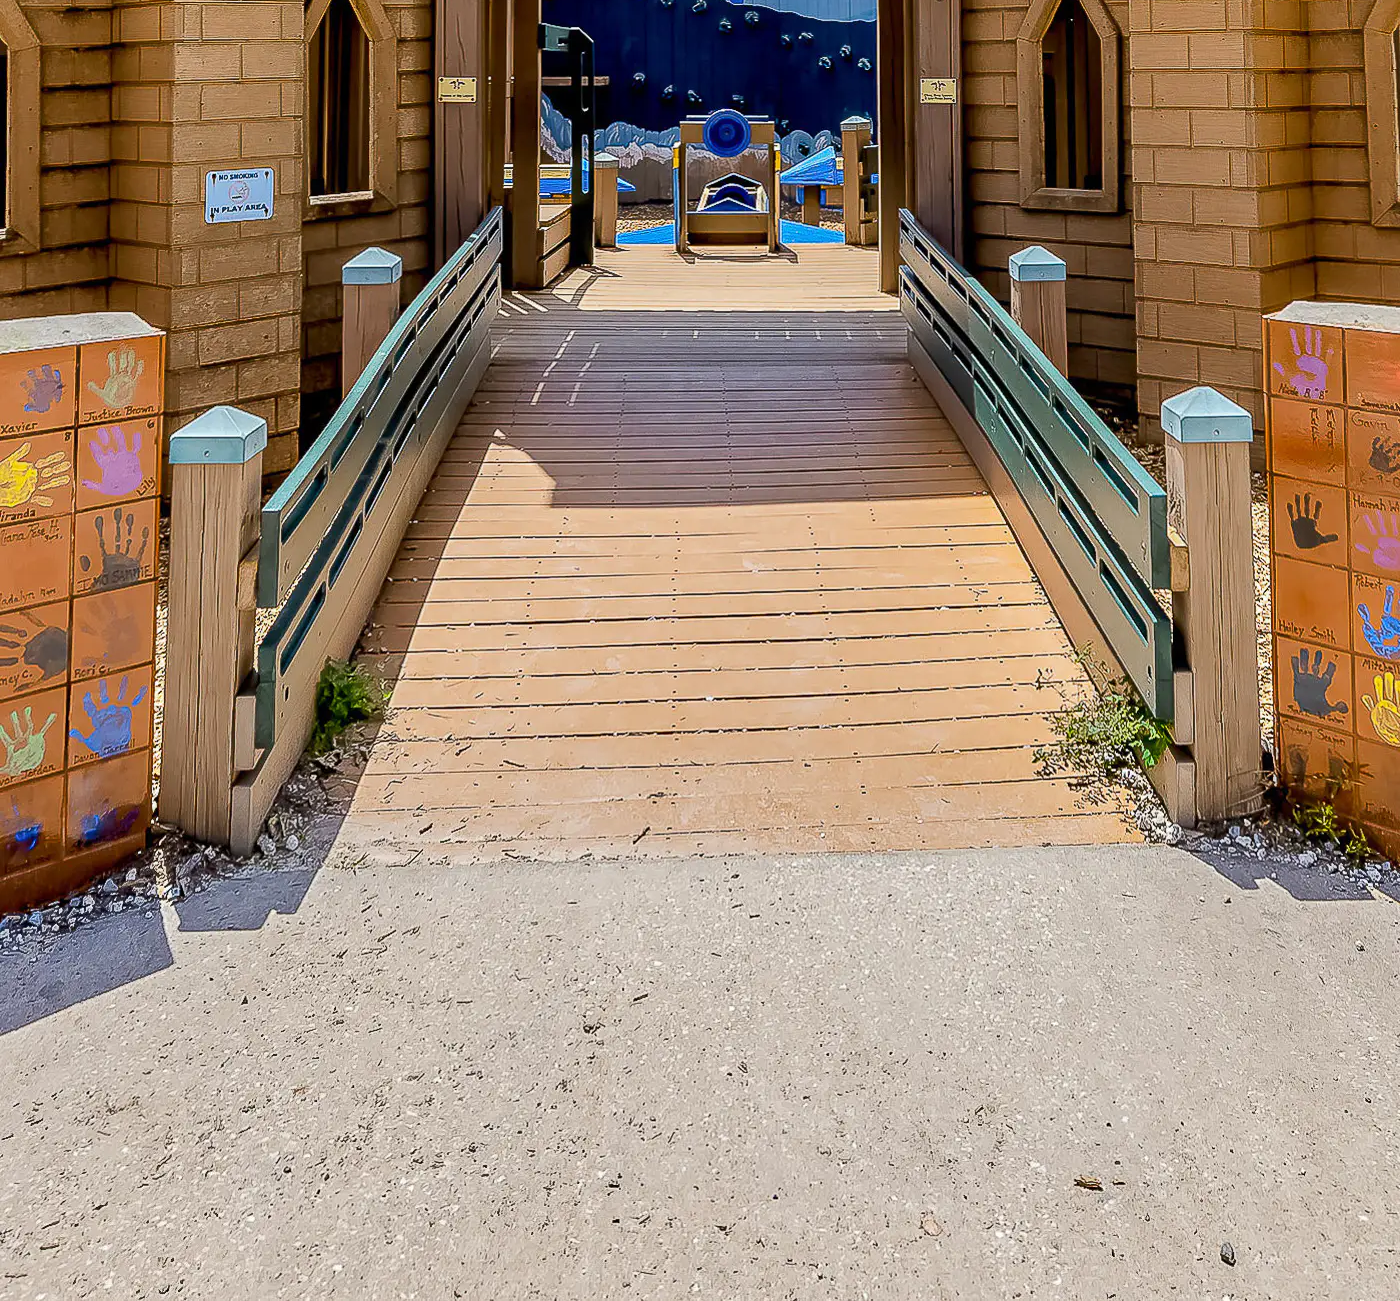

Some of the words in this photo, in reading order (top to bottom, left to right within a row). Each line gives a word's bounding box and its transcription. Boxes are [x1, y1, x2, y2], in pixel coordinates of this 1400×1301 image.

[230, 172, 259, 180] SMOKING
[222, 205, 244, 213] PLAY
[245, 203, 267, 211] AREA
[0, 507, 36, 522] iranda
